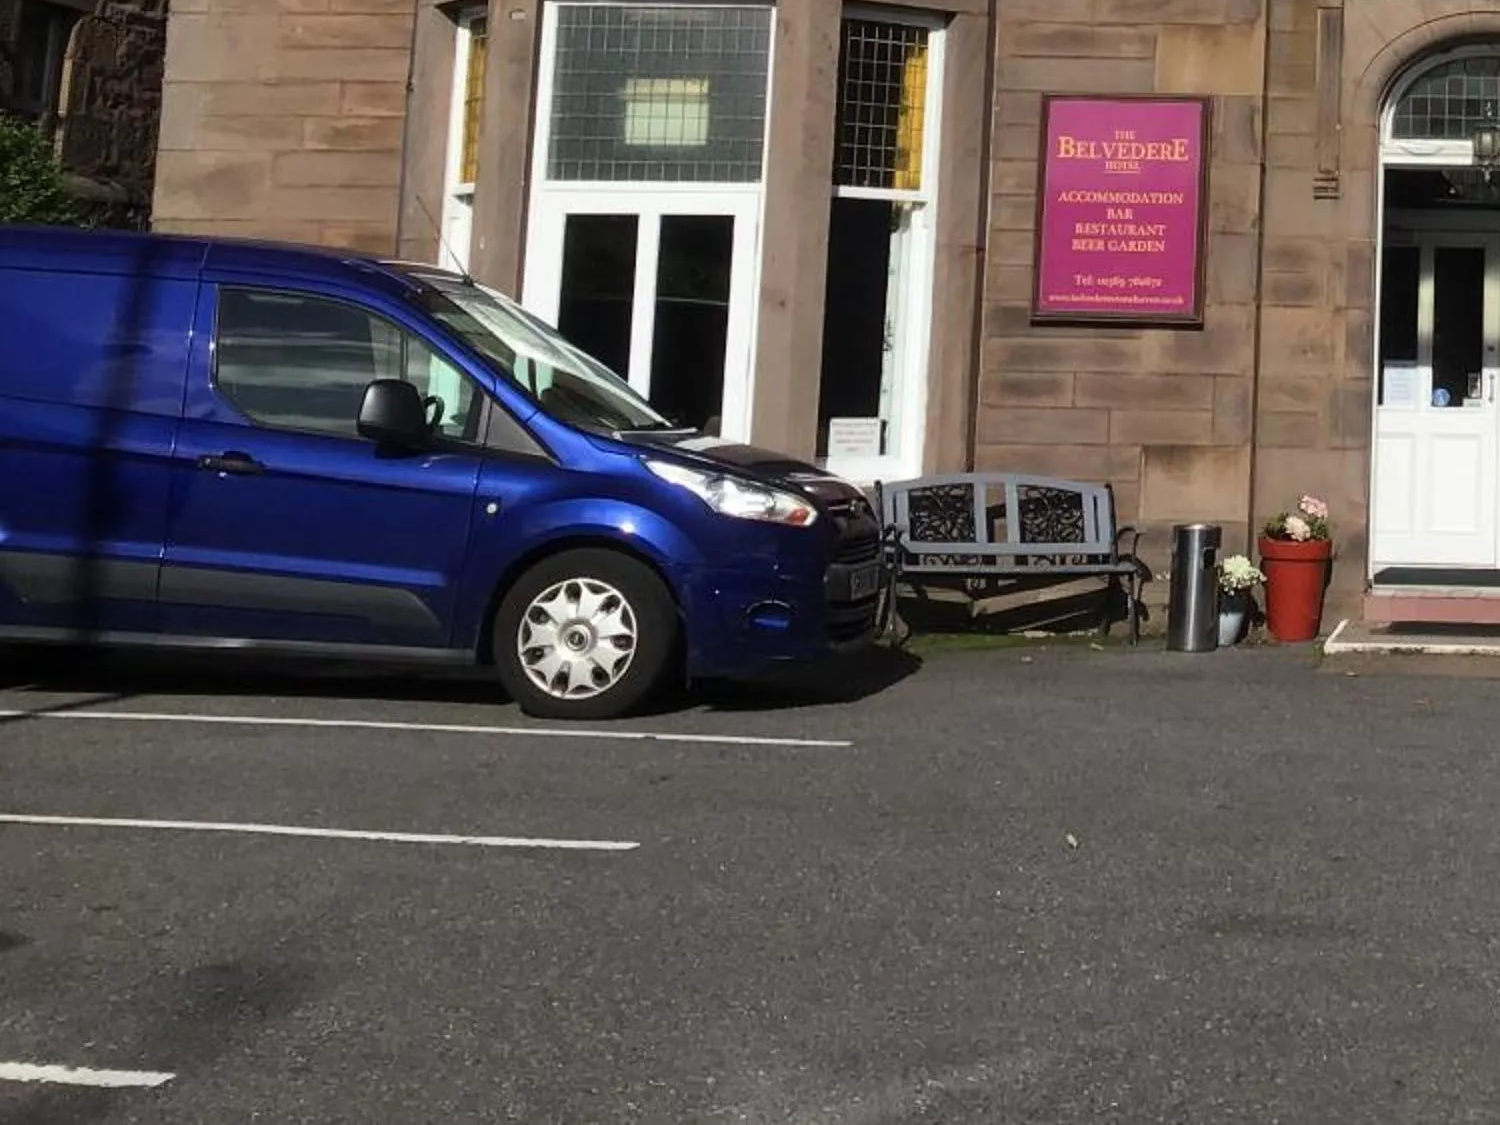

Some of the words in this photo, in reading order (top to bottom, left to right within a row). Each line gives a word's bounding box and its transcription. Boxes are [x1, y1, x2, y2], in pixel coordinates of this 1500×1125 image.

[1114, 130, 1136, 140] THE
[1056, 136, 1189, 162] BELVEDERE
[1105, 160, 1140, 170] HOTEL
[1058, 190, 1184, 204] ACCOMMODATION
[1106, 208, 1133, 220] BAR
[1075, 223, 1167, 236] RESTAURANT
[1071, 238, 1105, 251] BEER
[1107, 239, 1165, 252] GARDEN
